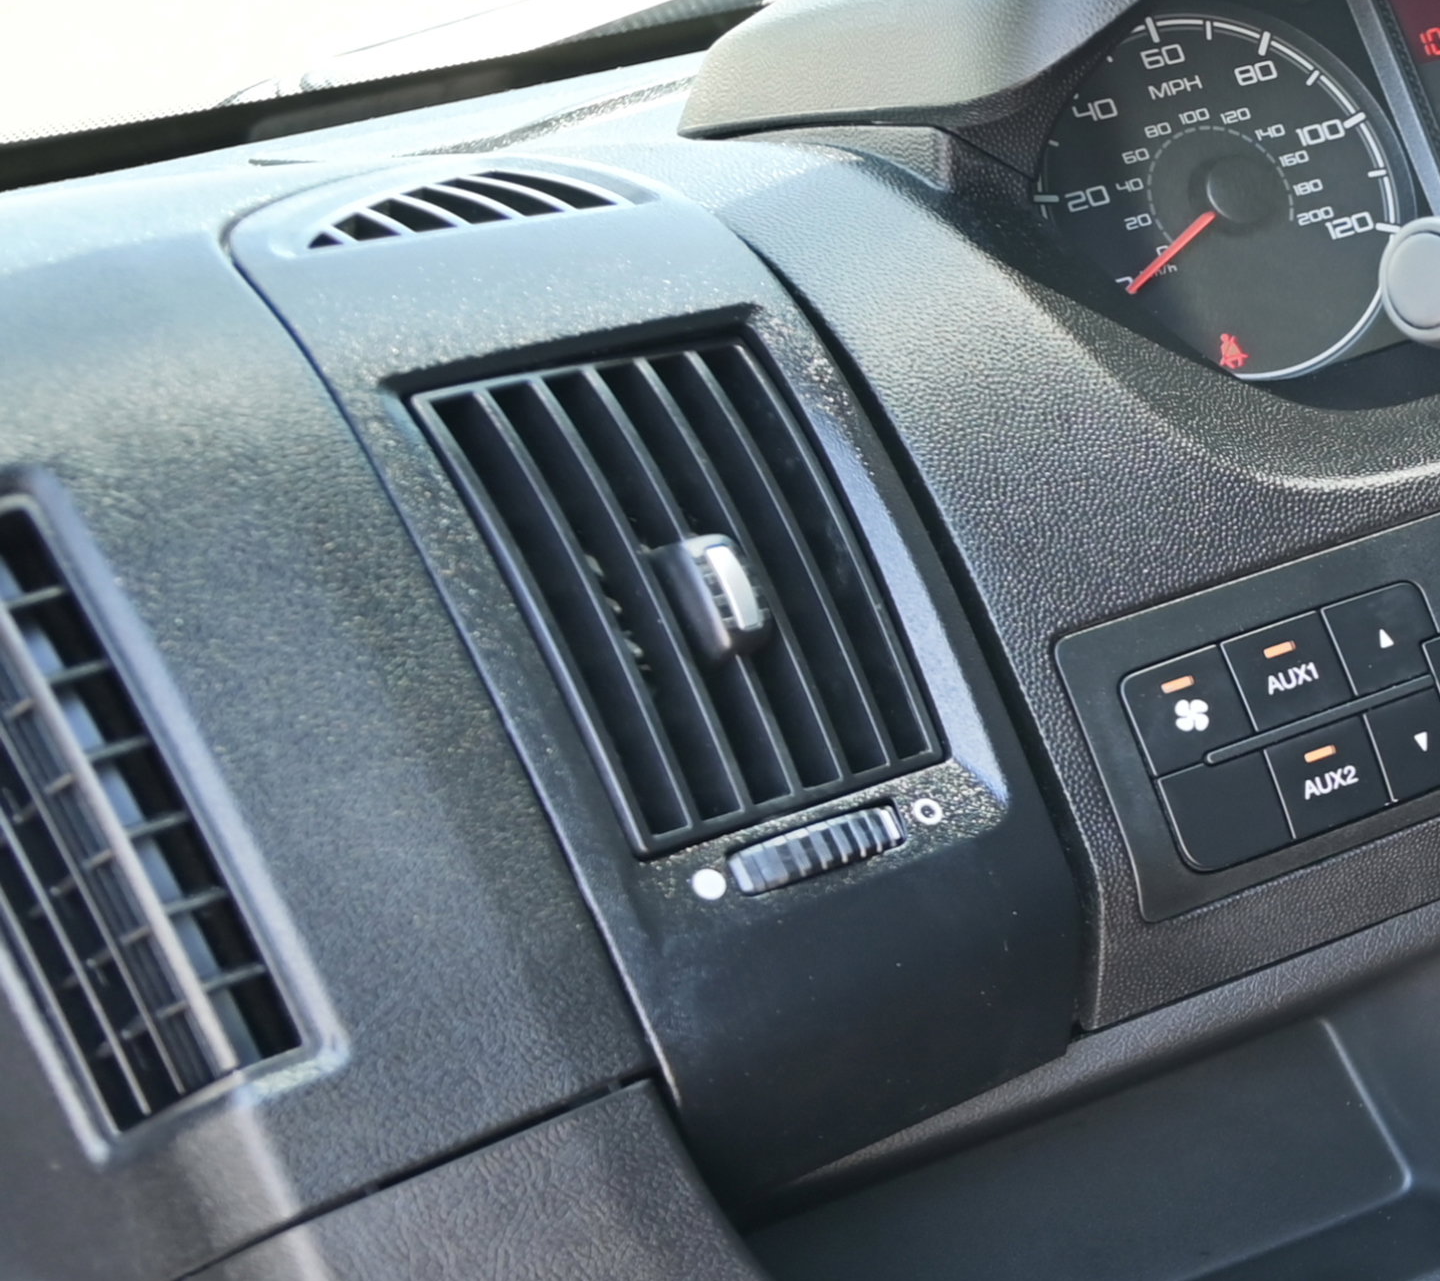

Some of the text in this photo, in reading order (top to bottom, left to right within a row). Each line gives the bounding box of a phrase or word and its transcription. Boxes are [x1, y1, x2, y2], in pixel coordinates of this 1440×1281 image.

[1140, 44, 1185, 69] 60
[1234, 60, 1277, 86] 80
[1148, 75, 1203, 100] MPH
[1072, 98, 1118, 121] 40
[1179, 107, 1210, 125] 100
[1221, 107, 1251, 125] 120
[1144, 121, 1172, 138] 80
[1255, 124, 1286, 141] 140
[1296, 119, 1345, 146] 100
[1122, 148, 1150, 165] 60
[1279, 150, 1309, 167] 160
[1116, 178, 1144, 193] 40
[1294, 179, 1323, 196] 180
[1065, 185, 1110, 212] 20
[1124, 214, 1152, 230] 20
[1297, 207, 1334, 226] 200
[1326, 212, 1373, 240] 120
[1267, 662, 1319, 695] AUX1
[1304, 765, 1359, 800] AUX2
